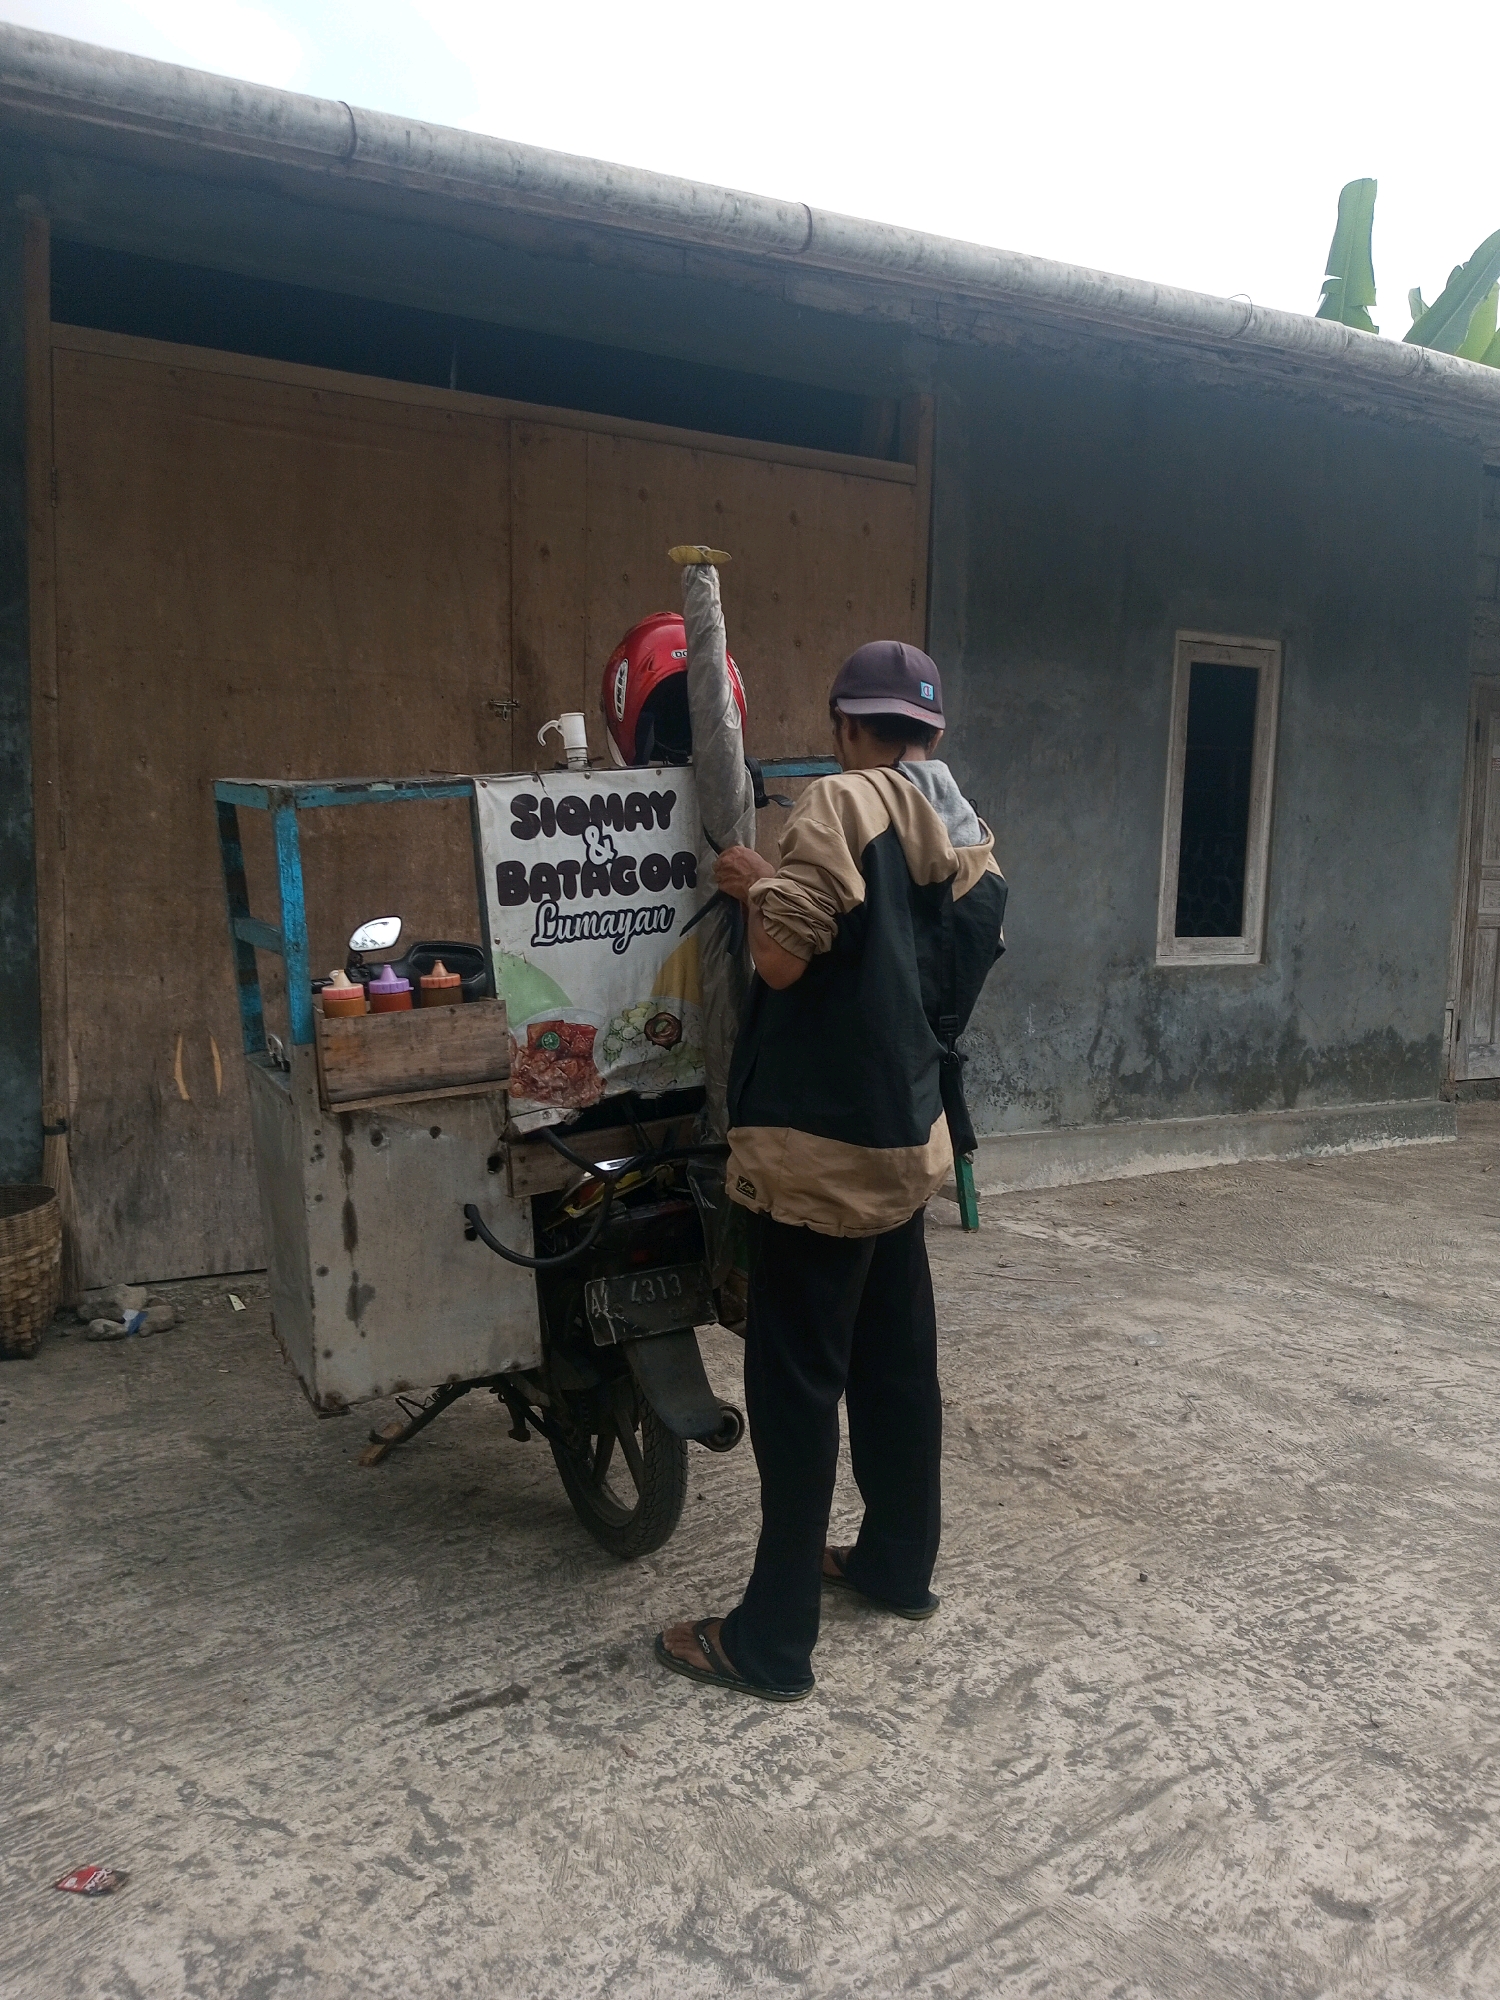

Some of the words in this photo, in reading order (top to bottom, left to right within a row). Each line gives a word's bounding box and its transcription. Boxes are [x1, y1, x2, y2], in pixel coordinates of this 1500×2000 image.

[615, 668, 626, 714] INK
[510, 790, 677, 840] SIOMAY
[582, 824, 618, 865] &
[496, 851, 698, 906] BATAGOR
[531, 900, 676, 955] Lumayan
